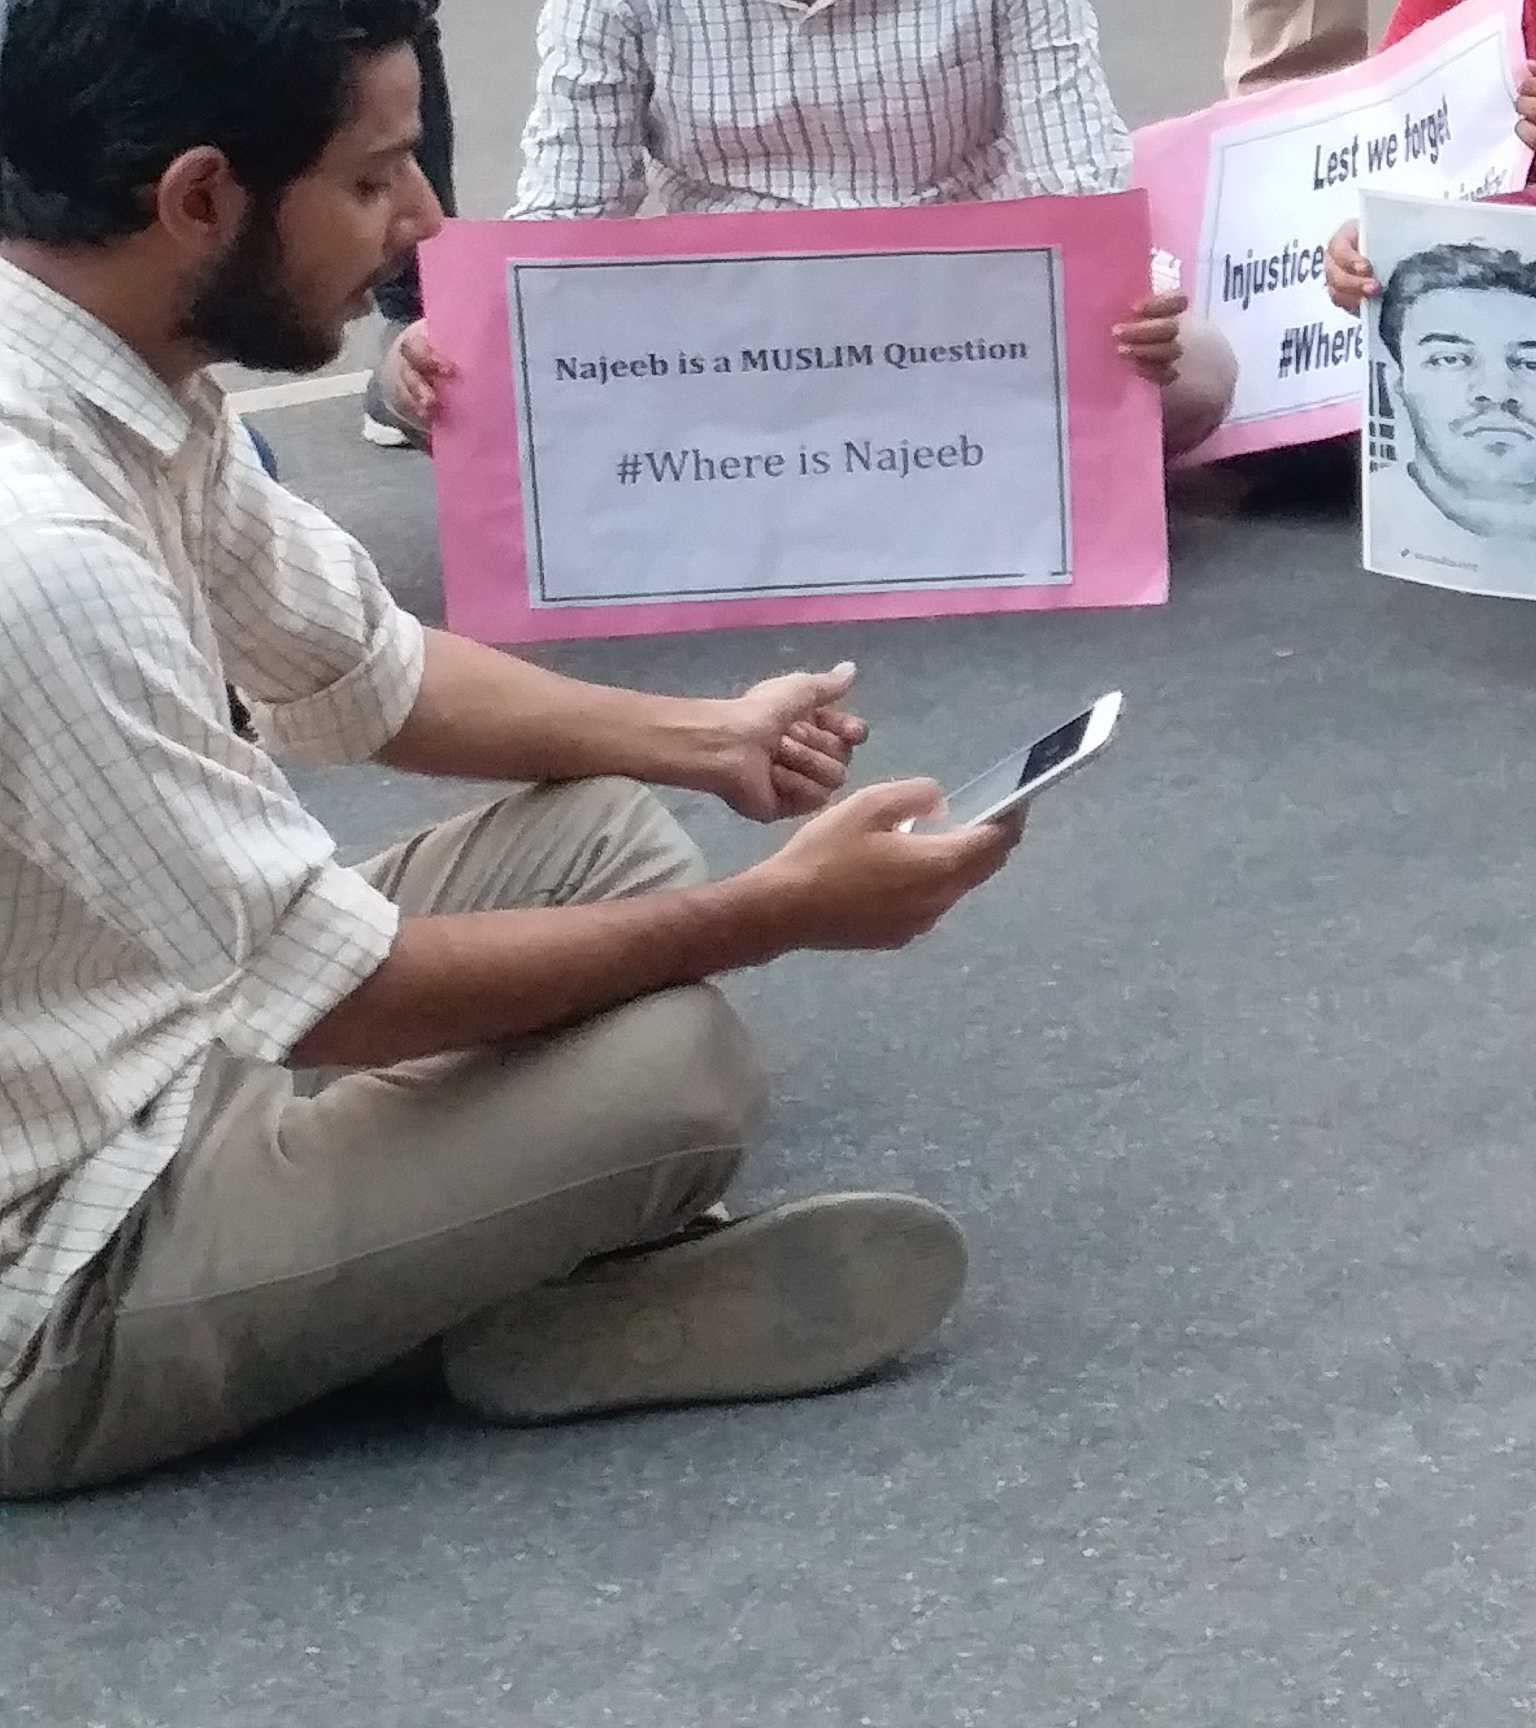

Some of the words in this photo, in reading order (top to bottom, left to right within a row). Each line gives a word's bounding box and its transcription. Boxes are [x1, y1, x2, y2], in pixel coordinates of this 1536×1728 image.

[1313, 134, 1358, 191] Lest
[1367, 133, 1399, 173] we
[1404, 95, 1452, 165] forget
[1222, 238, 1325, 310] Injustice
[555, 351, 669, 387] Najeeb
[678, 350, 706, 378] is
[712, 354, 732, 376] a
[740, 342, 875, 373] MUSLIM
[884, 335, 1030, 370] Question
[617, 448, 785, 487] #Where
[798, 444, 832, 477] is
[844, 434, 985, 478] Najeeb
